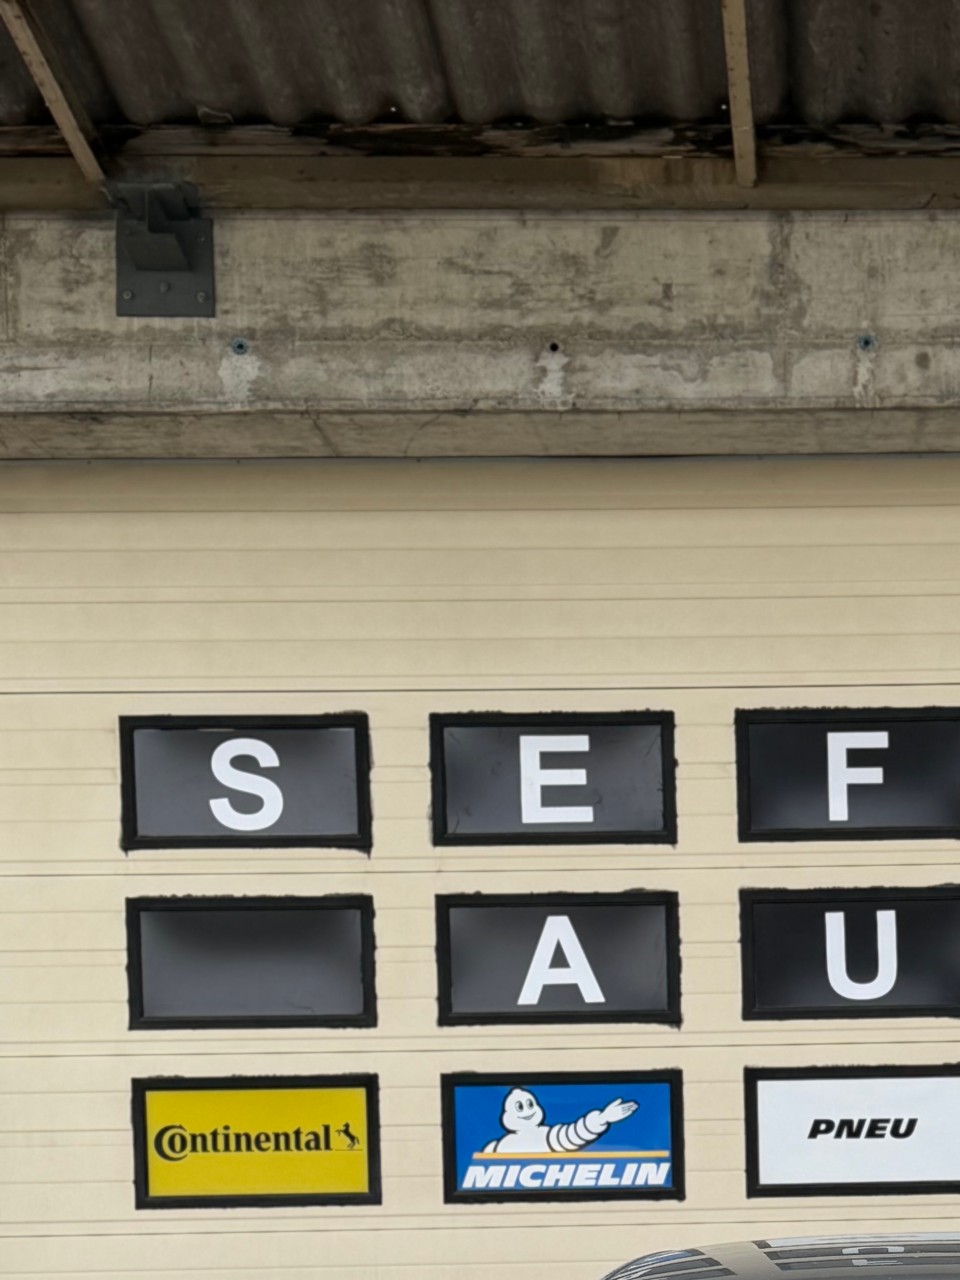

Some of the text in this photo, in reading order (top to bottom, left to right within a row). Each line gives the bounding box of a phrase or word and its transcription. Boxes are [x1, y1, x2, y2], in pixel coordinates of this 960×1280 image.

[153, 1124, 333, 1162] Continental
[808, 1116, 918, 1141] PNEU
[461, 1159, 672, 1190] MICHELIN
